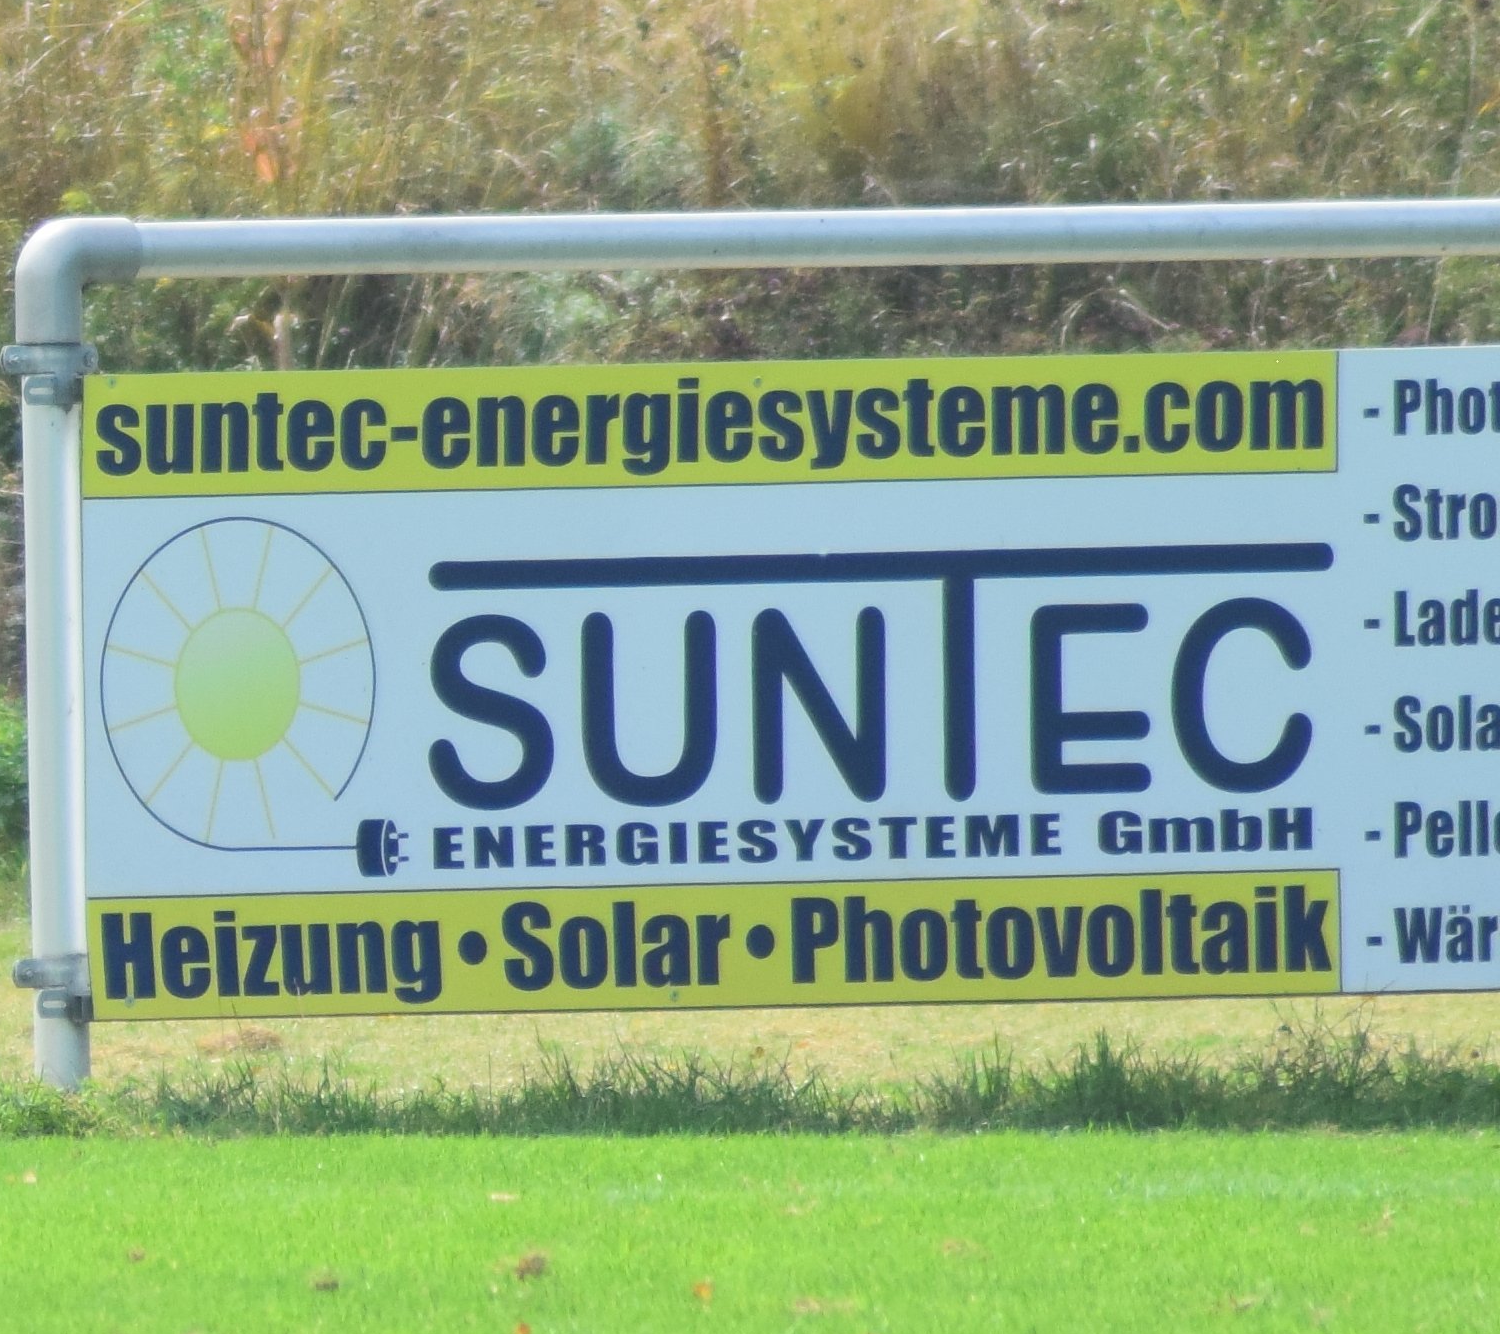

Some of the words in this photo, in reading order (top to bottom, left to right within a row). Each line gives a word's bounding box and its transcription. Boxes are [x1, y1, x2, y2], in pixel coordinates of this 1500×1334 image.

[96, 378, 1324, 477] suntec-energiesysteme.com
[427, 543, 1334, 811] SUNTEC
[432, 813, 1062, 869] ENERGIESYSTEME
[1097, 807, 1313, 855] GmbH
[101, 910, 443, 1004] Heizung
[502, 900, 731, 991] Solar
[790, 885, 1333, 984] Photovoltaik
